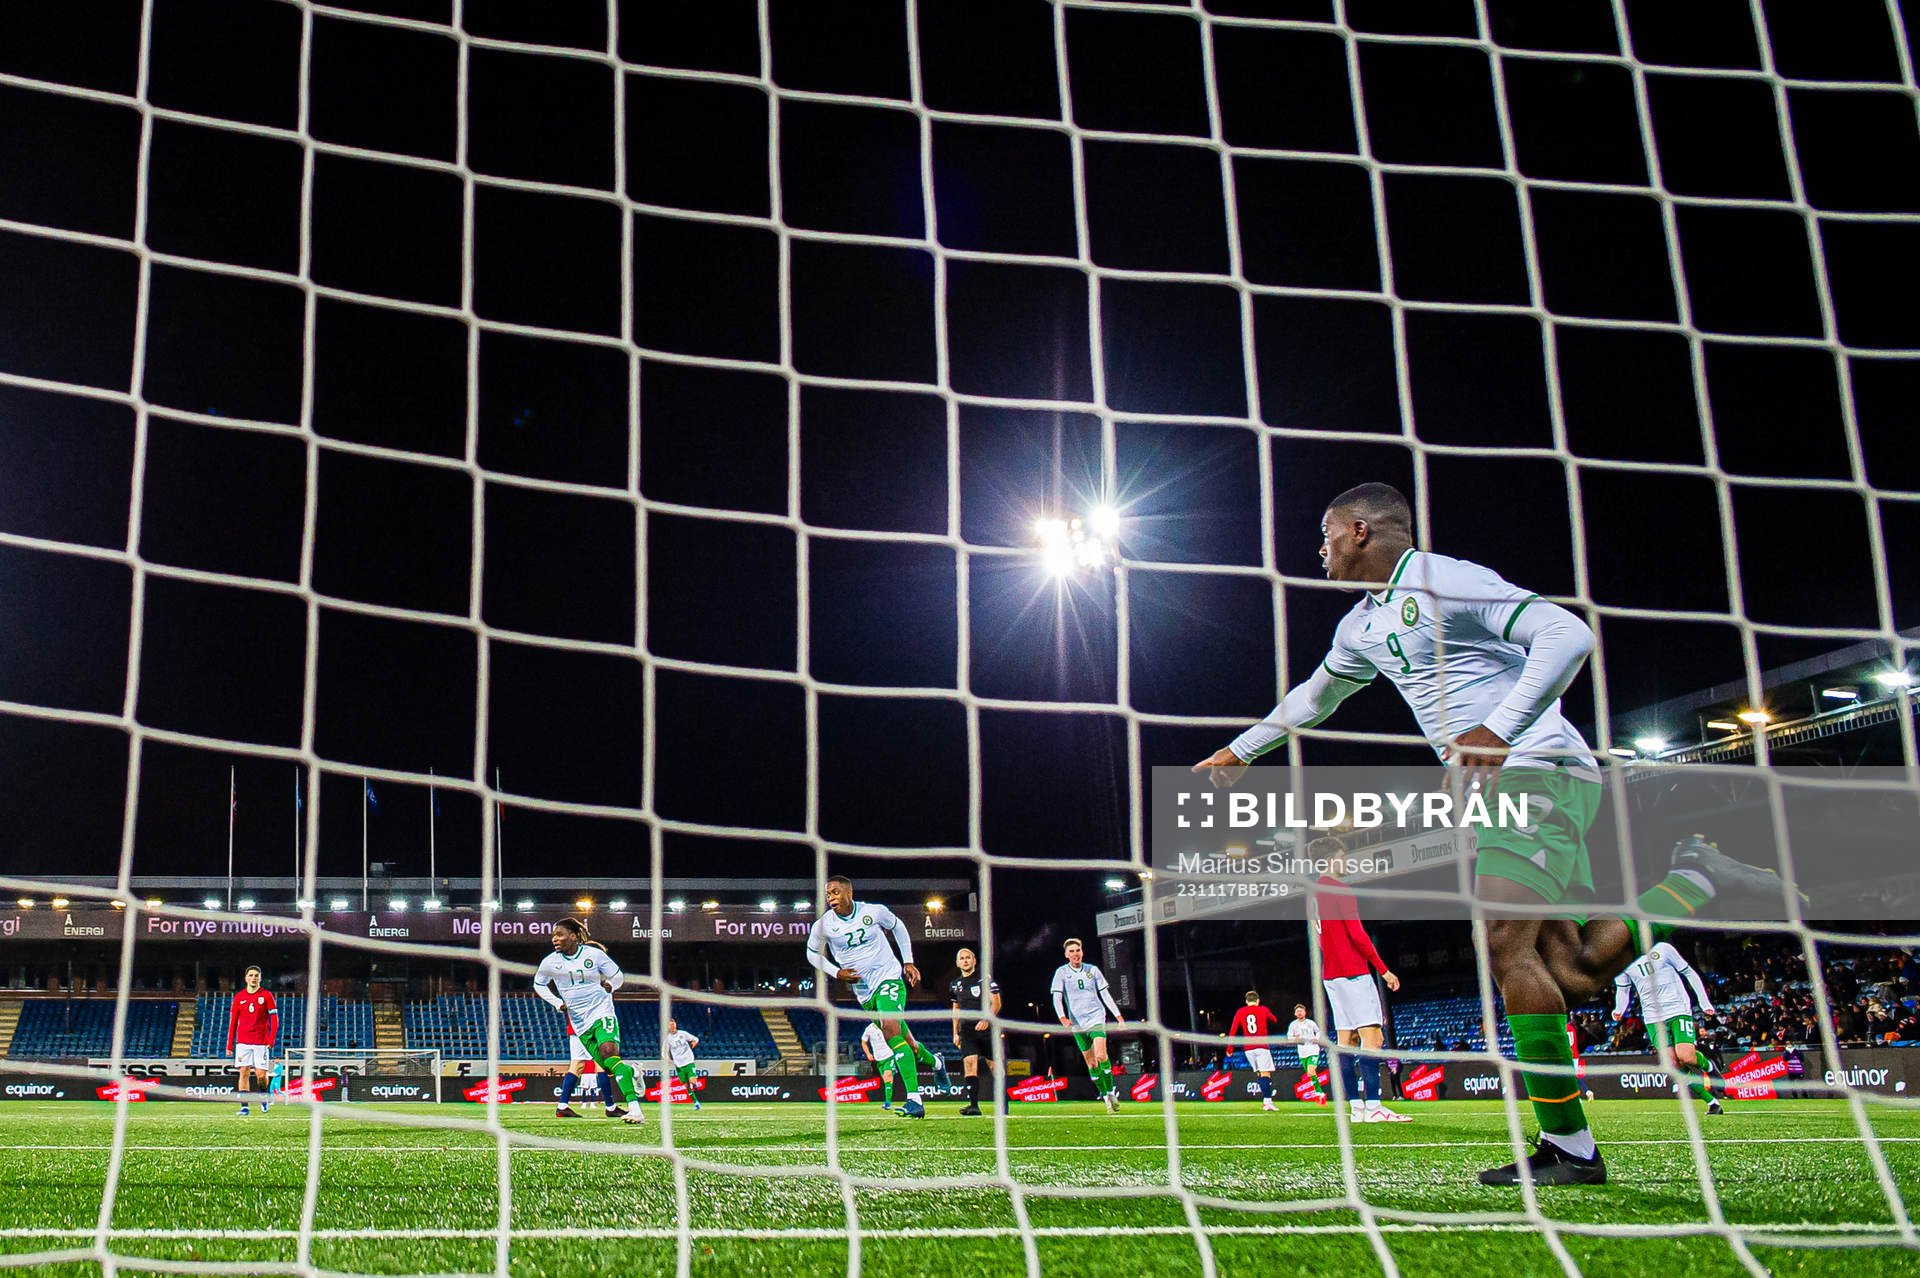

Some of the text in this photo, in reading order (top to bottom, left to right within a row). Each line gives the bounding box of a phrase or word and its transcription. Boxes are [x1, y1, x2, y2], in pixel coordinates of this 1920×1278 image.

[1386, 632, 1412, 675] 9
[147, 918, 180, 933] For
[184, 920, 217, 936] nye
[370, 915, 378, 927] Å
[494, 922, 524, 934] ren
[632, 916, 641, 928] Å
[924, 916, 933, 927] Å
[64, 927, 104, 936] ENERGI
[369, 928, 409, 937] ENERGI
[632, 929, 672, 938] ENEGI
[715, 920, 746, 935] For
[751, 922, 784, 938] nye
[925, 929, 964, 937] ENERGI
[844, 927, 868, 948] 22
[568, 969, 585, 986] 13
[1077, 979, 1085, 990] 8
[248, 1003, 255, 1013] 6
[602, 1016, 615, 1034] 13
[1246, 1014, 1258, 1034] 8
[1620, 1073, 1668, 1092] equinor
[1824, 1067, 1889, 1087] equinor
[5, 1083, 54, 1097] equinor
[185, 1084, 235, 1098] equinor
[371, 1084, 420, 1098] equinor
[731, 1084, 780, 1098] equinor
[918, 1085, 963, 1098] equor
[1463, 1074, 1500, 1095] equinor
[1738, 1084, 1768, 1098] HELTER
